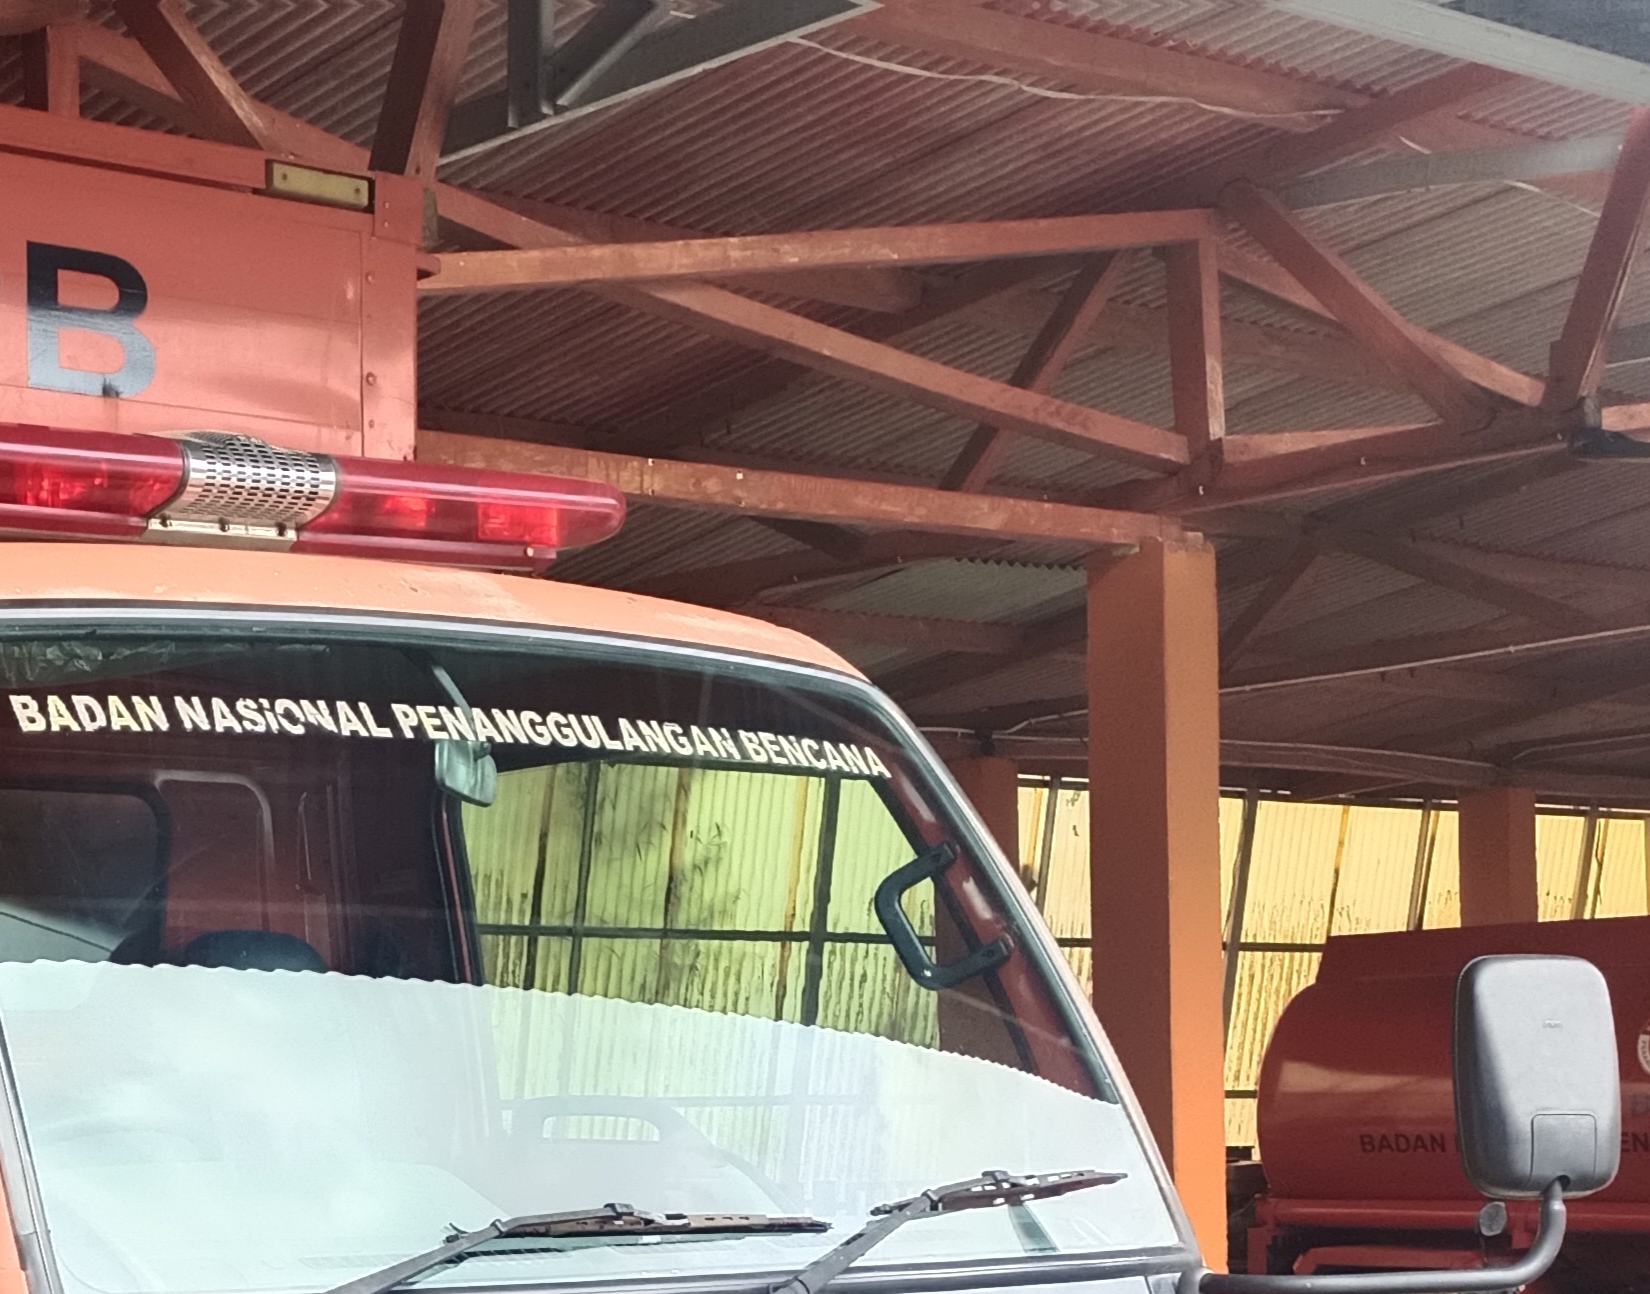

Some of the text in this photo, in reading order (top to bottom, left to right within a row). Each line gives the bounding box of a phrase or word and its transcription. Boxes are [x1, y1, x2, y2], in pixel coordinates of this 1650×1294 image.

[9, 694, 892, 779] BADAN NASIONAL PENANGGULANGAN BENCANA
[1359, 1133, 1447, 1153] BADAN
